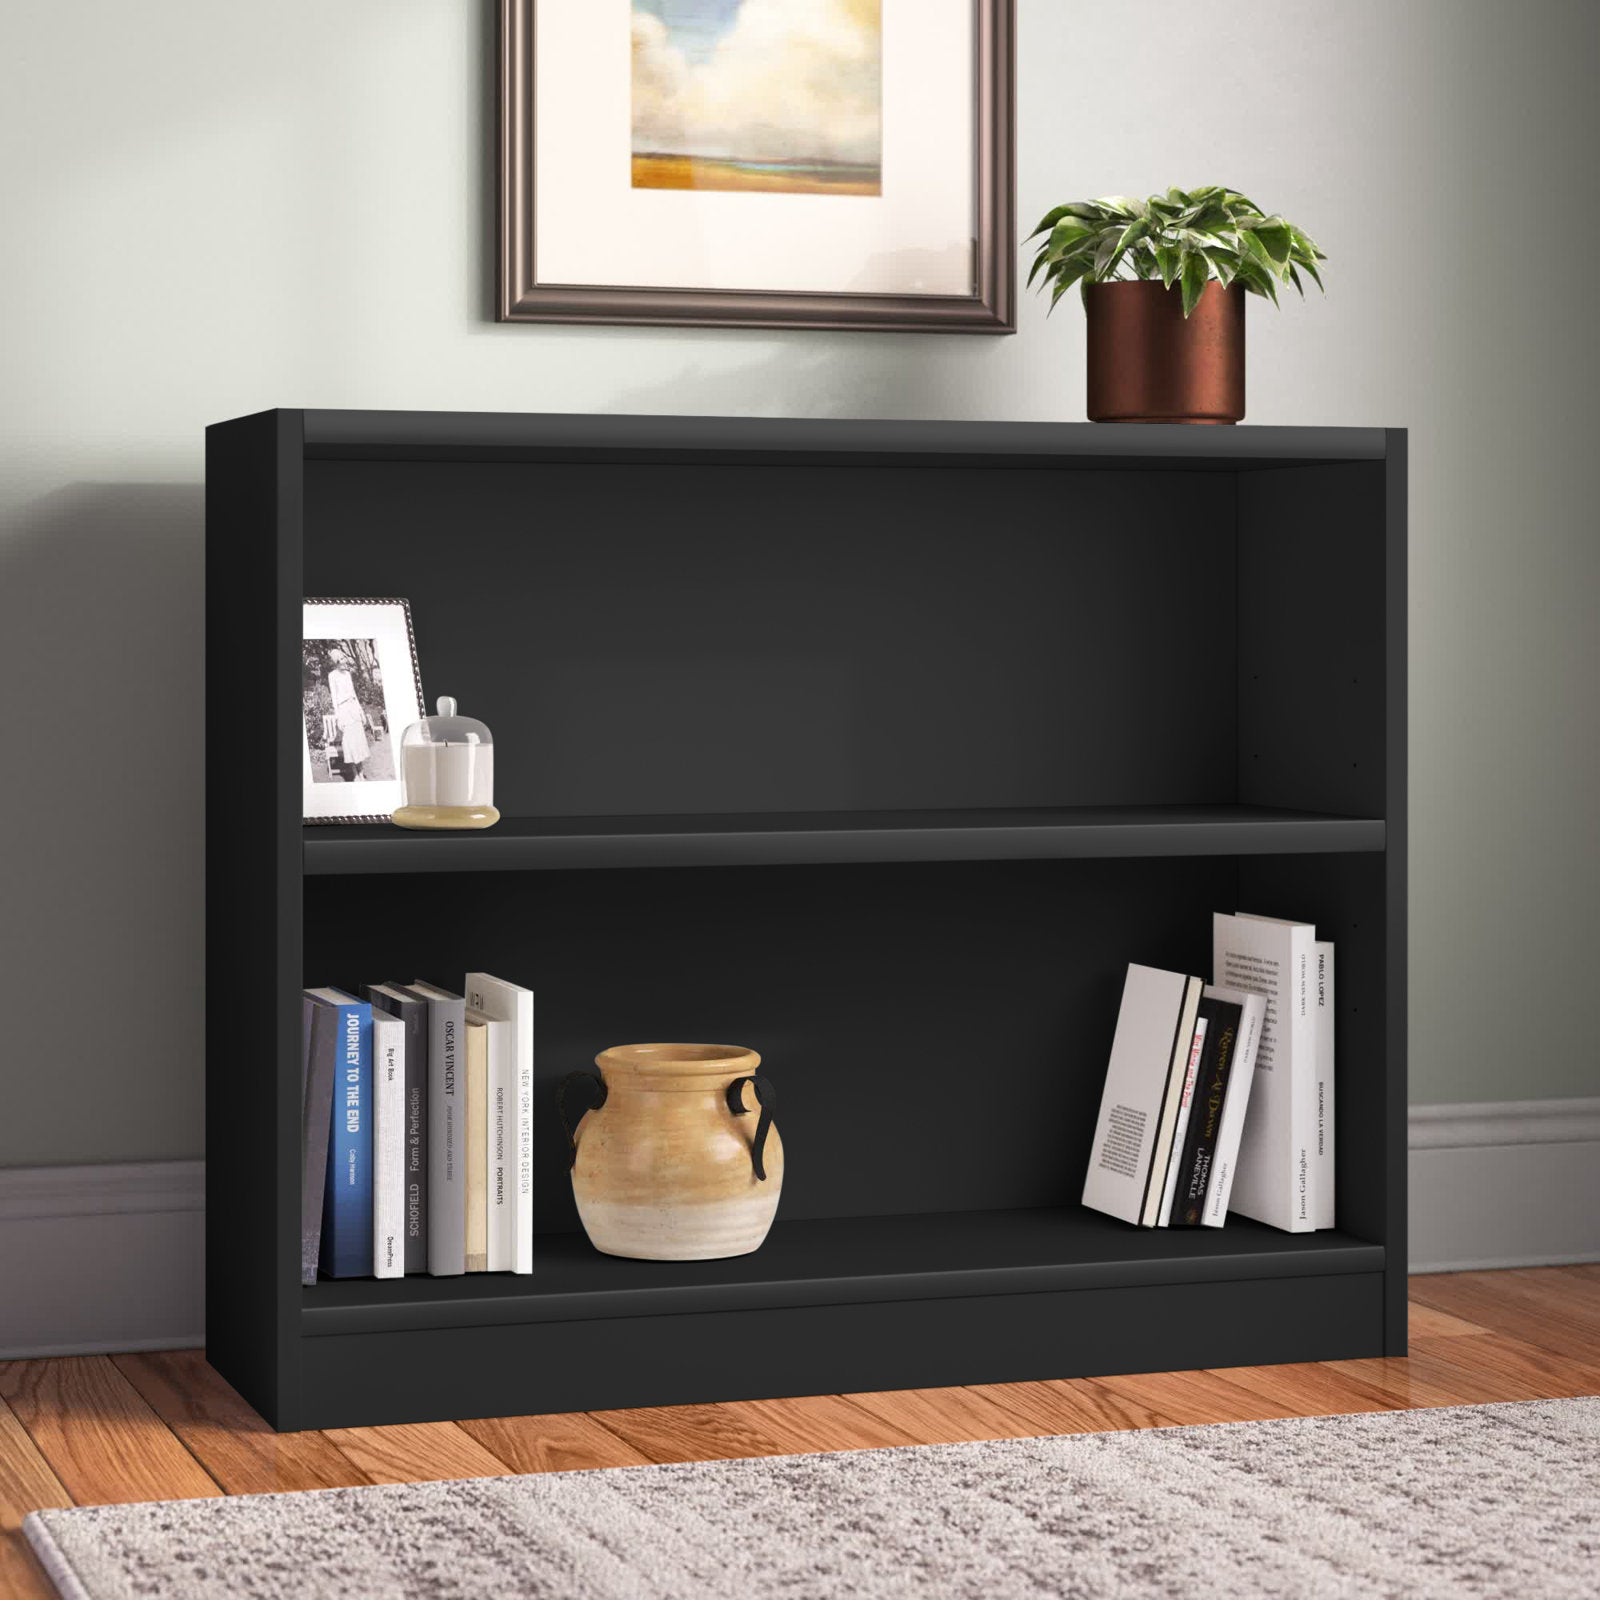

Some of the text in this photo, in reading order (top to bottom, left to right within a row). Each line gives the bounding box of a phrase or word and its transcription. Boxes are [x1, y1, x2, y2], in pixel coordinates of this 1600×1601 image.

[346, 1013, 360, 1133] JOURNEY TO THE END
[386, 1048, 395, 1081] Big Art Book
[445, 1020, 455, 1096] OSCAR VINCENT
[496, 1087, 504, 1205] ROBERT HUTCHINSON PORTRAITS
[521, 1069, 530, 1194] NEW YORK INTERIOR DESIGN
[1318, 1119, 1324, 1128] LA
[409, 1087, 419, 1237] SCHOFIELD Form & Perfection
[1189, 1147, 1205, 1200] LANEVILLE
[1196, 1155, 1210, 1196] THOMAS
[1299, 1149, 1308, 1220] Jason Gallagher
[386, 1236, 395, 1268] DreamPress
